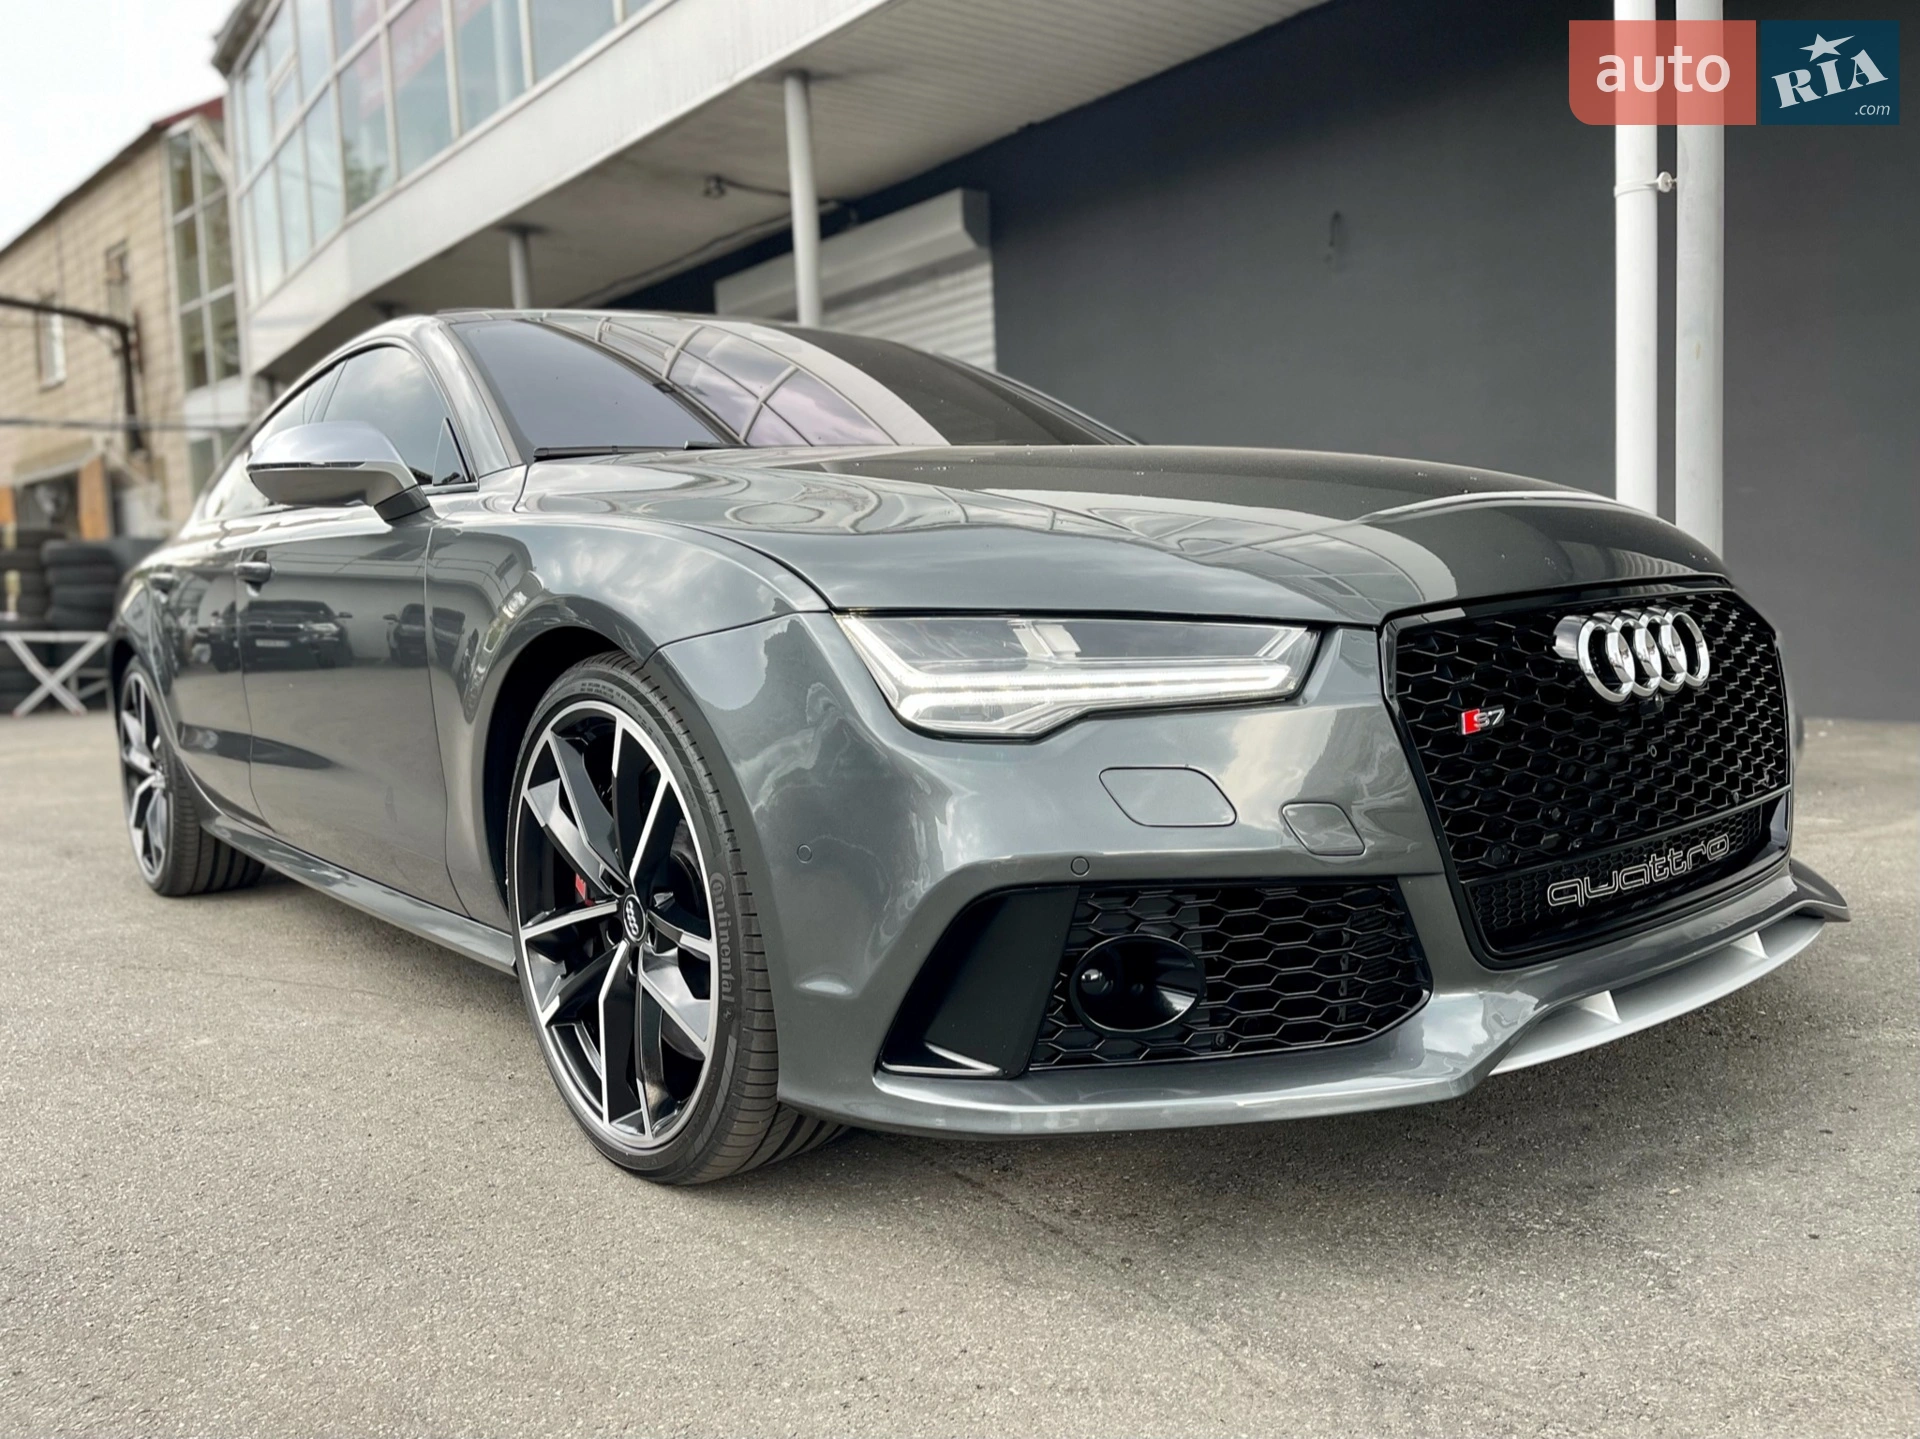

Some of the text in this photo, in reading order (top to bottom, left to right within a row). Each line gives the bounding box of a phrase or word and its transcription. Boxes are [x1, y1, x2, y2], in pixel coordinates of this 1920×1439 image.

[1473, 708, 1506, 728] S7
[1547, 833, 1730, 908] quattro
[709, 872, 736, 1003] Continental
